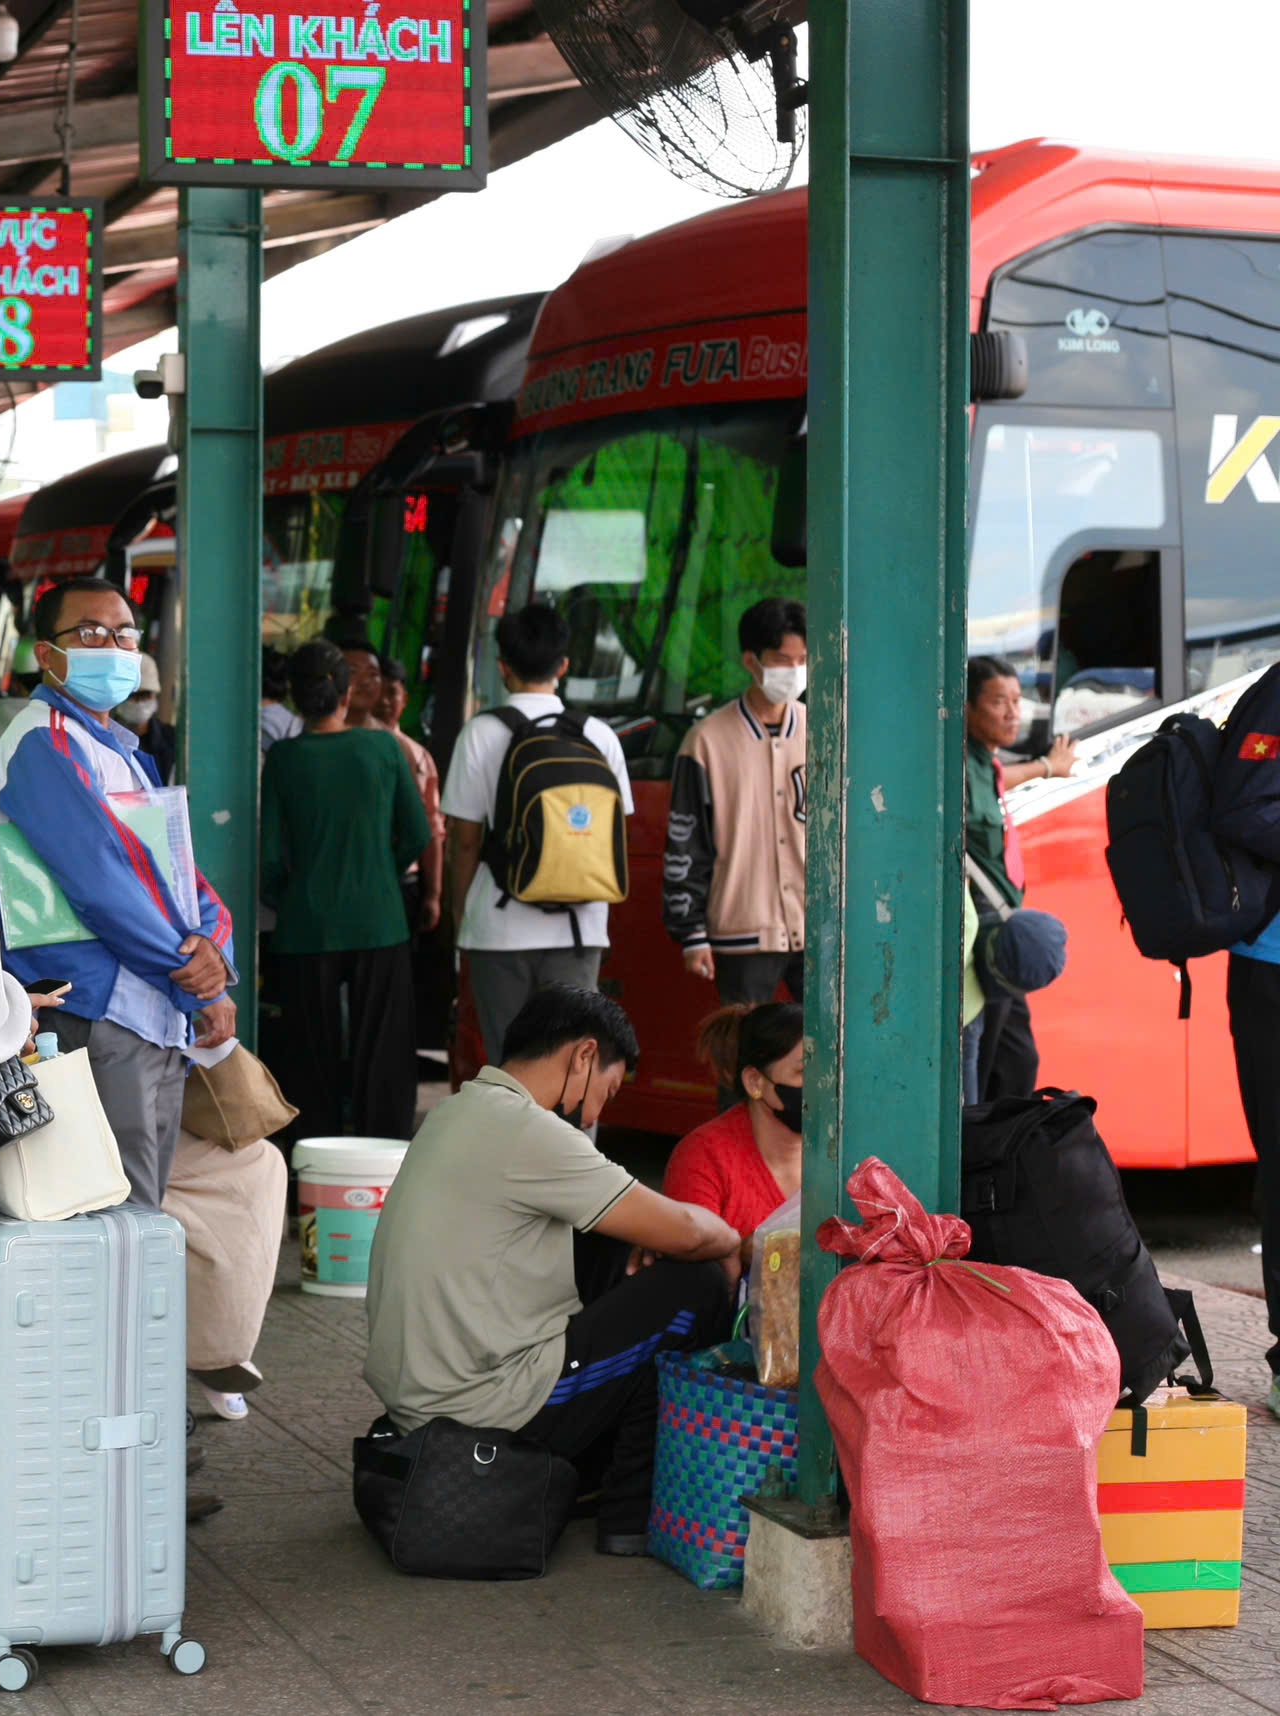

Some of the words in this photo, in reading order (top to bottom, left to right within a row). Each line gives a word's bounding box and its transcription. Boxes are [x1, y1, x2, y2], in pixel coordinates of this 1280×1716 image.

[185, 1, 275, 57] LÊN
[288, 3, 452, 63] KHÁCH
[253, 61, 387, 160] 07
[660, 337, 741, 388] FUTA
[1057, 337, 1085, 352] KIM
[1086, 338, 1120, 353] LONG
